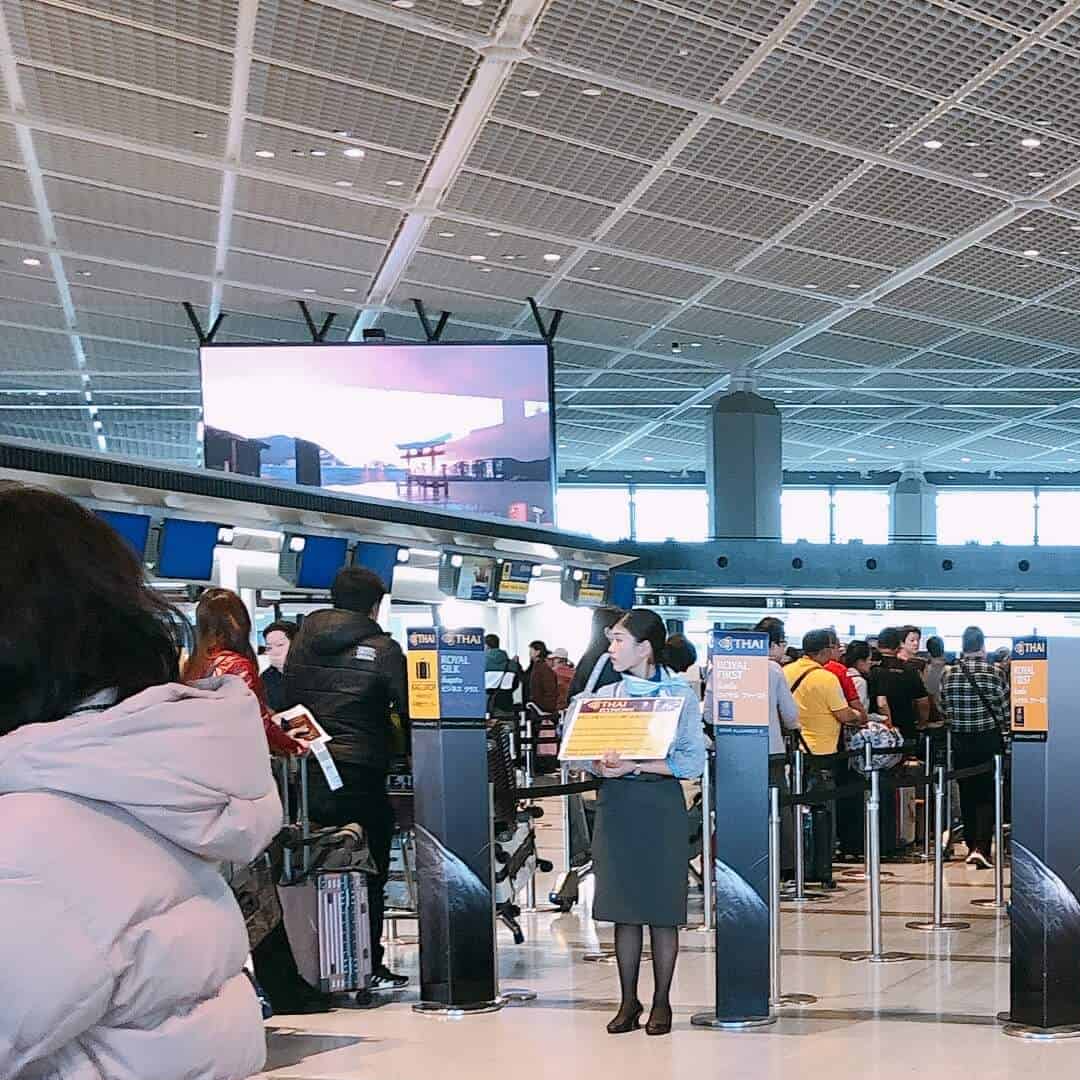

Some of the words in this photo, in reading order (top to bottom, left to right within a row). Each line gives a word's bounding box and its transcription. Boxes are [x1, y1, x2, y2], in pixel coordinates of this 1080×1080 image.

[417, 633, 435, 644] THAI
[456, 634, 481, 644] THAI
[735, 639, 763, 649] THAI
[1024, 643, 1045, 653] THAI
[441, 655, 470, 665] ROYAL
[441, 665, 460, 674] SILK
[718, 660, 750, 671] ROYAL
[718, 671, 743, 680] FIRST
